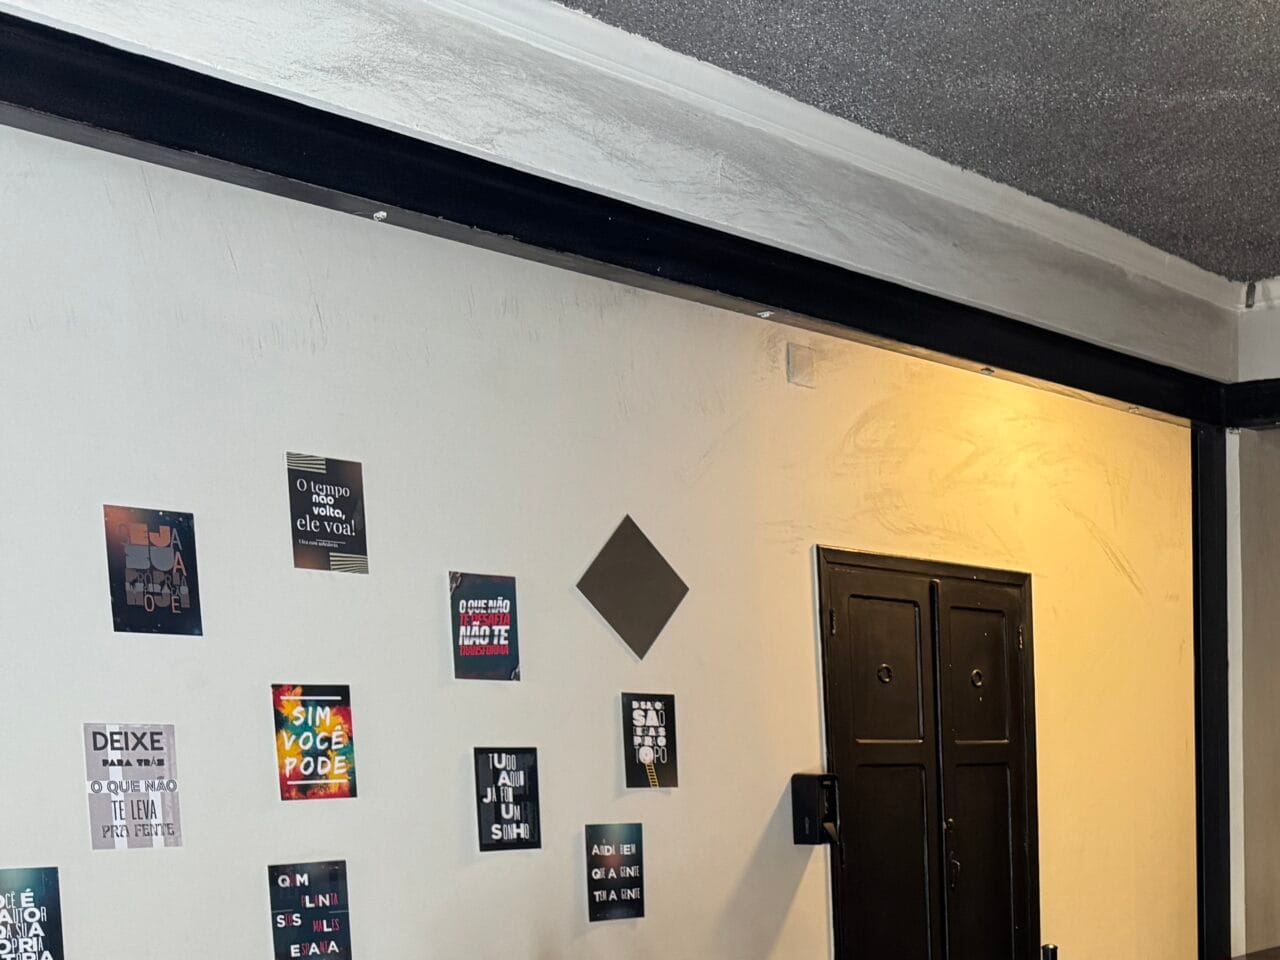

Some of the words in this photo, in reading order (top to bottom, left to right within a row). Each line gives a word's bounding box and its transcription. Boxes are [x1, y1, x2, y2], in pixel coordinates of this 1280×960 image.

[296, 478, 307, 492] O
[311, 480, 350, 498] tempo
[312, 505, 345, 520] volta,
[296, 514, 320, 532] ele
[323, 519, 356, 536] voa!
[459, 599, 466, 613] O
[467, 599, 487, 615] QUE
[488, 596, 510, 613] NÃO
[459, 620, 490, 645] NÃO
[492, 625, 510, 645] TE
[292, 706, 331, 726] SIM
[92, 731, 164, 751] DEIXE
[282, 725, 344, 750] VOCÊ
[102, 758, 132, 767] PARA
[488, 753, 517, 770] TUDO
[634, 746, 667, 764] TOPO
[284, 756, 347, 778] PODE
[90, 780, 103, 793] O
[106, 780, 140, 795] QUE
[145, 776, 178, 793] NÃO
[482, 784, 497, 803] JÁ
[111, 800, 125, 820] TE
[130, 799, 157, 820] LEVA
[501, 803, 521, 820] UM
[102, 824, 130, 838] PRA
[134, 823, 175, 837] FENTE
[491, 823, 530, 840] SONHO
[608, 867, 617, 879] A
[20, 888, 35, 908] É
[608, 889, 618, 901] A
[16, 921, 46, 938] SUA
